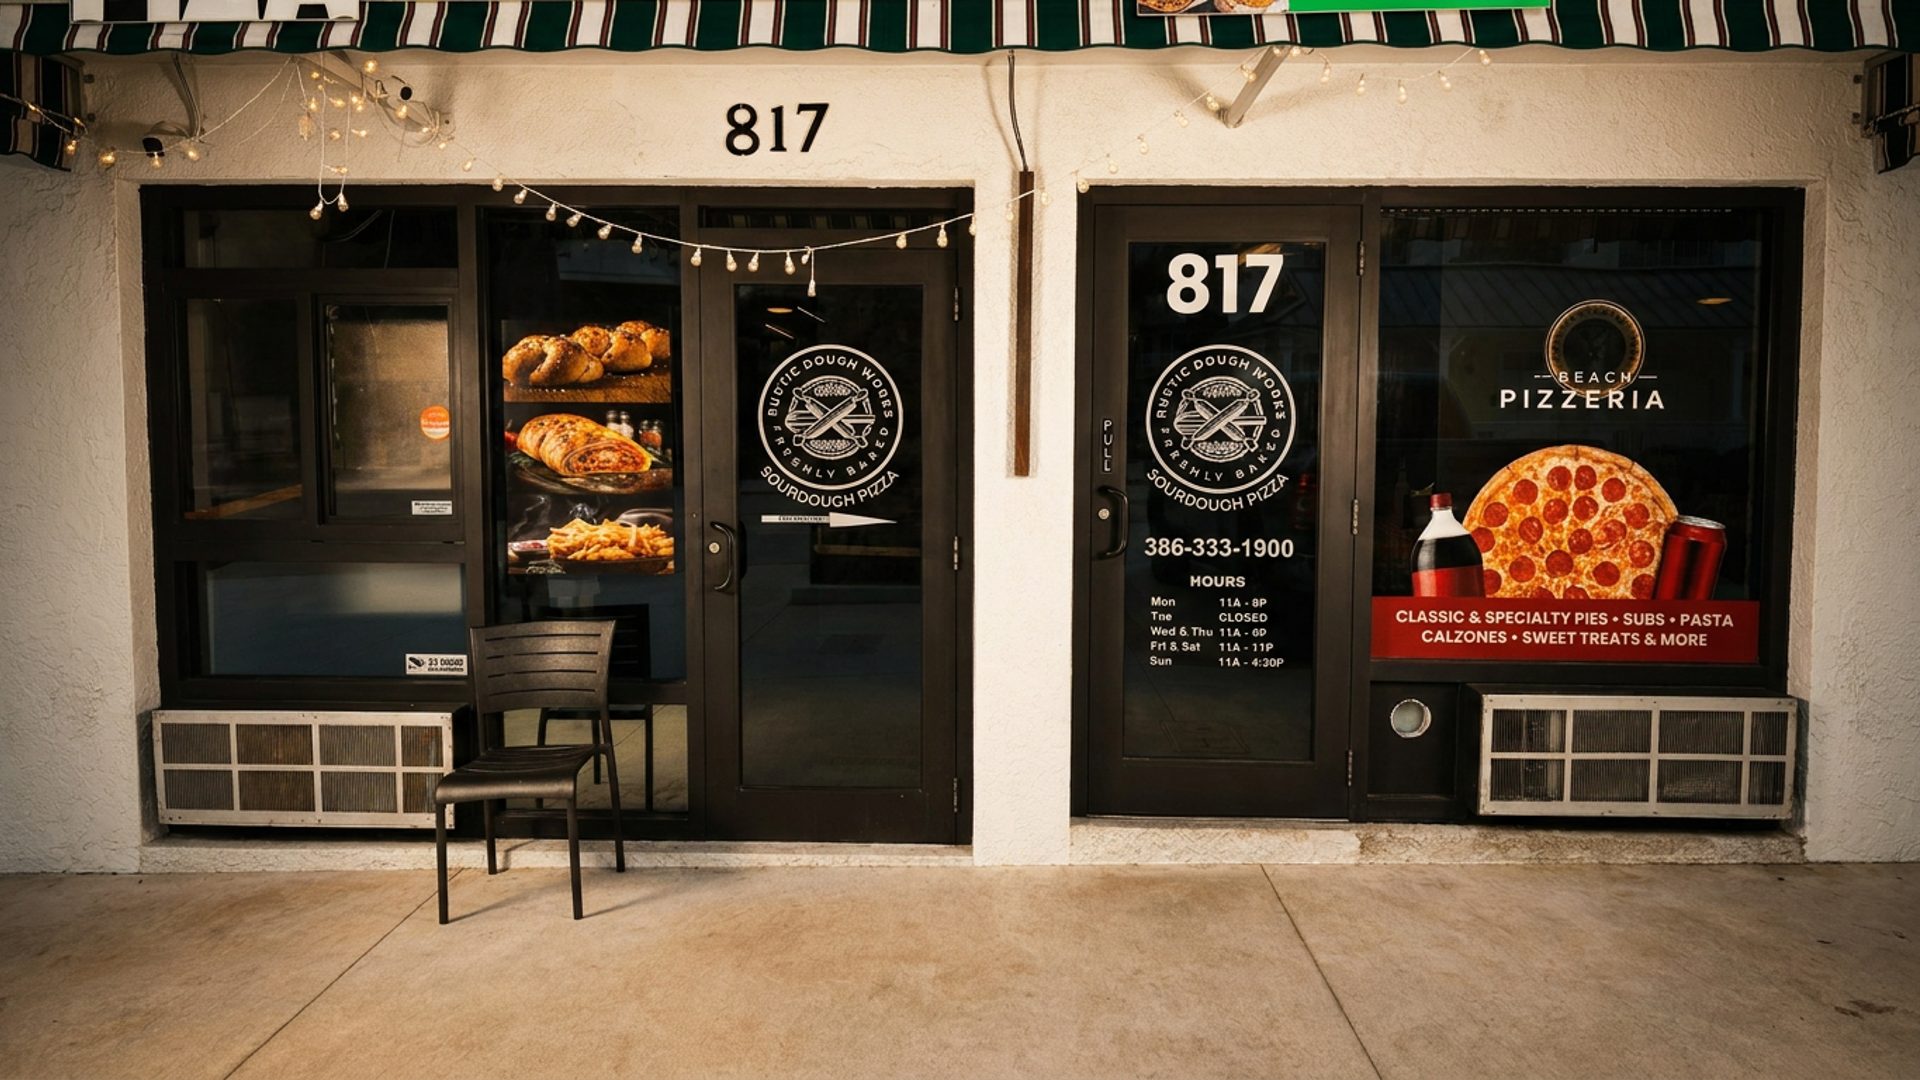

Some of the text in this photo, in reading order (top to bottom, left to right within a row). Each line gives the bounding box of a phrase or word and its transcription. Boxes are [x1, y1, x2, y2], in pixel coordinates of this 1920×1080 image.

[725, 102, 829, 156] 817
[1166, 252, 1284, 314] 817
[803, 355, 858, 370] DOUGH
[1193, 355, 1250, 370] DOUGH
[1500, 389, 1665, 410] PIZZERIA
[1104, 420, 1113, 471] PULL
[760, 465, 900, 508] SOURDOUGH PIZZA
[1246, 473, 1290, 506] PIZZA
[1144, 537, 1295, 558] 386-333-1900
[1189, 575, 1246, 588] HOURS
[1151, 596, 1176, 607] Mon
[1251, 598, 1267, 608] 8P
[1218, 612, 1268, 623] CLOSED
[1395, 610, 1734, 627] CLASSIC & SPECIALTY PIES SUBS PASTA
[1150, 626, 1176, 637] Wed
[1191, 626, 1214, 637] Thu
[1421, 630, 1708, 647] CALZONES SWEET TREATS & MORE
[1181, 641, 1201, 652] Sat
[1252, 643, 1274, 653] 11P
[1150, 656, 1172, 666] Sun
[1218, 658, 1240, 668] 11A
[1251, 658, 1284, 669] 4:30P
